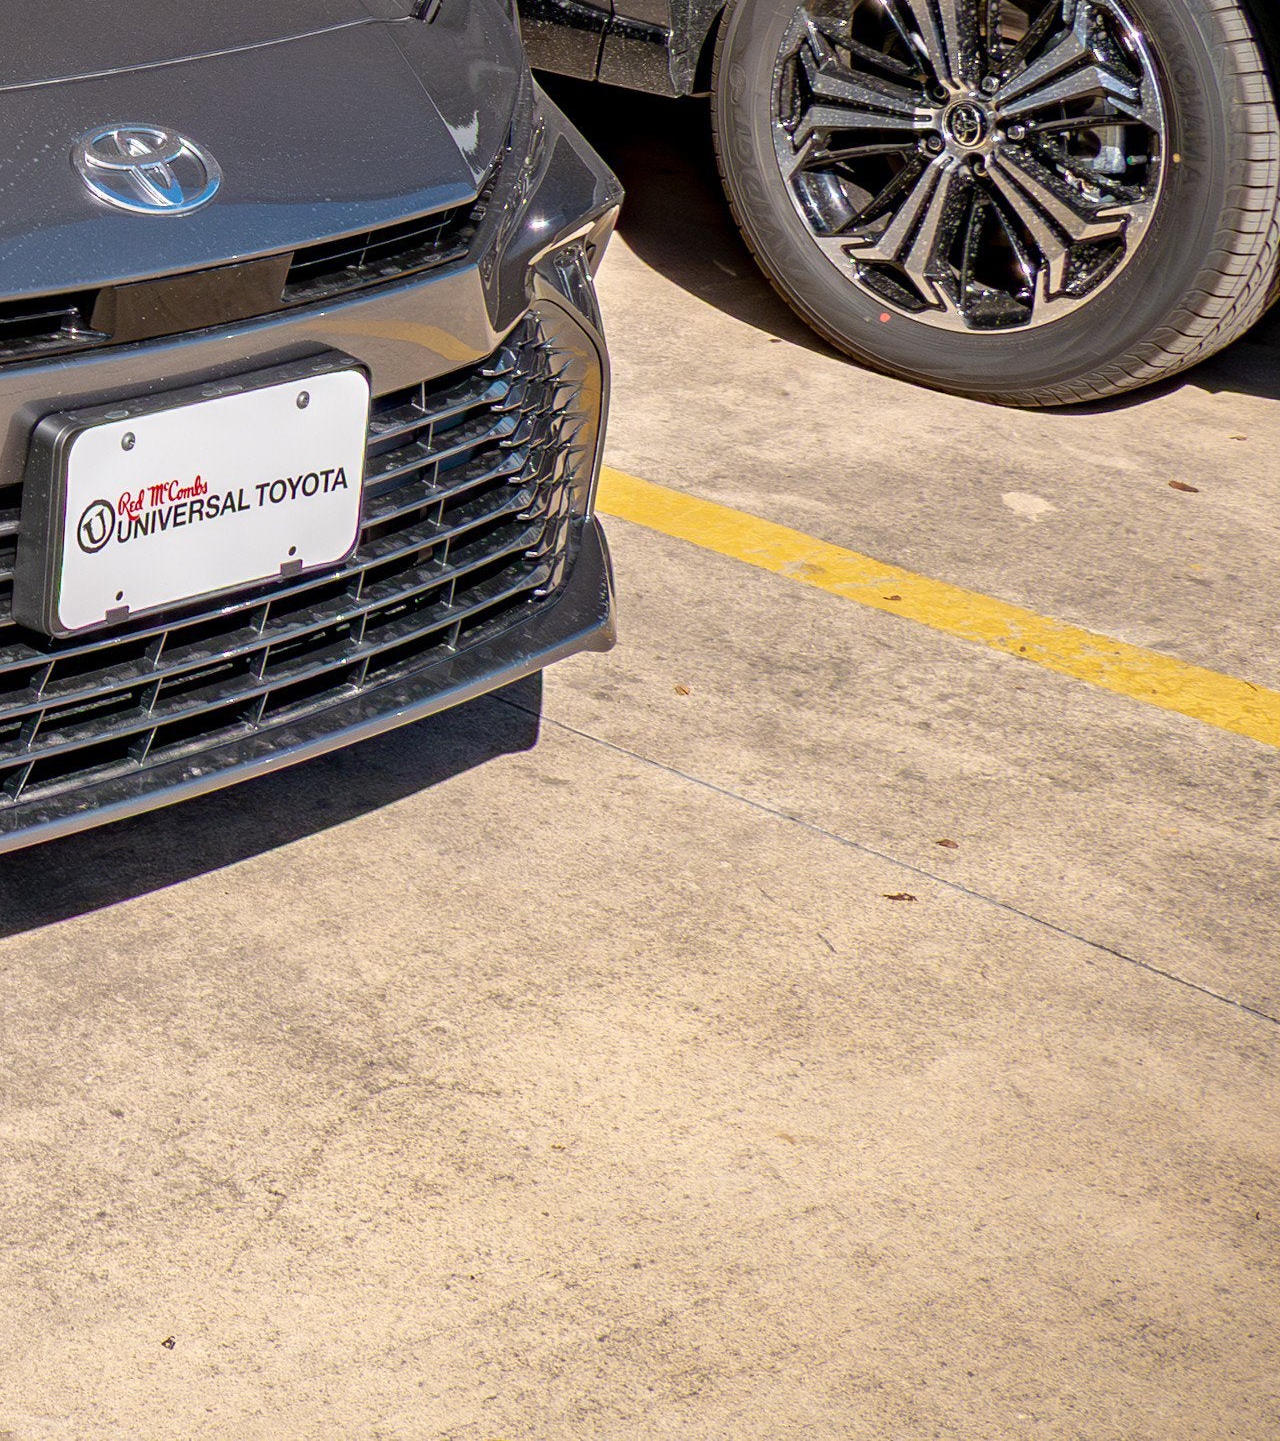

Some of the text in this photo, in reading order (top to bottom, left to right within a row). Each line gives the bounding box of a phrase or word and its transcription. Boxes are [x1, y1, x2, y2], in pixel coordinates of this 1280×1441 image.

[117, 475, 208, 521] Red McCombs
[117, 466, 349, 544] UNIVERSAL TOYOTA
